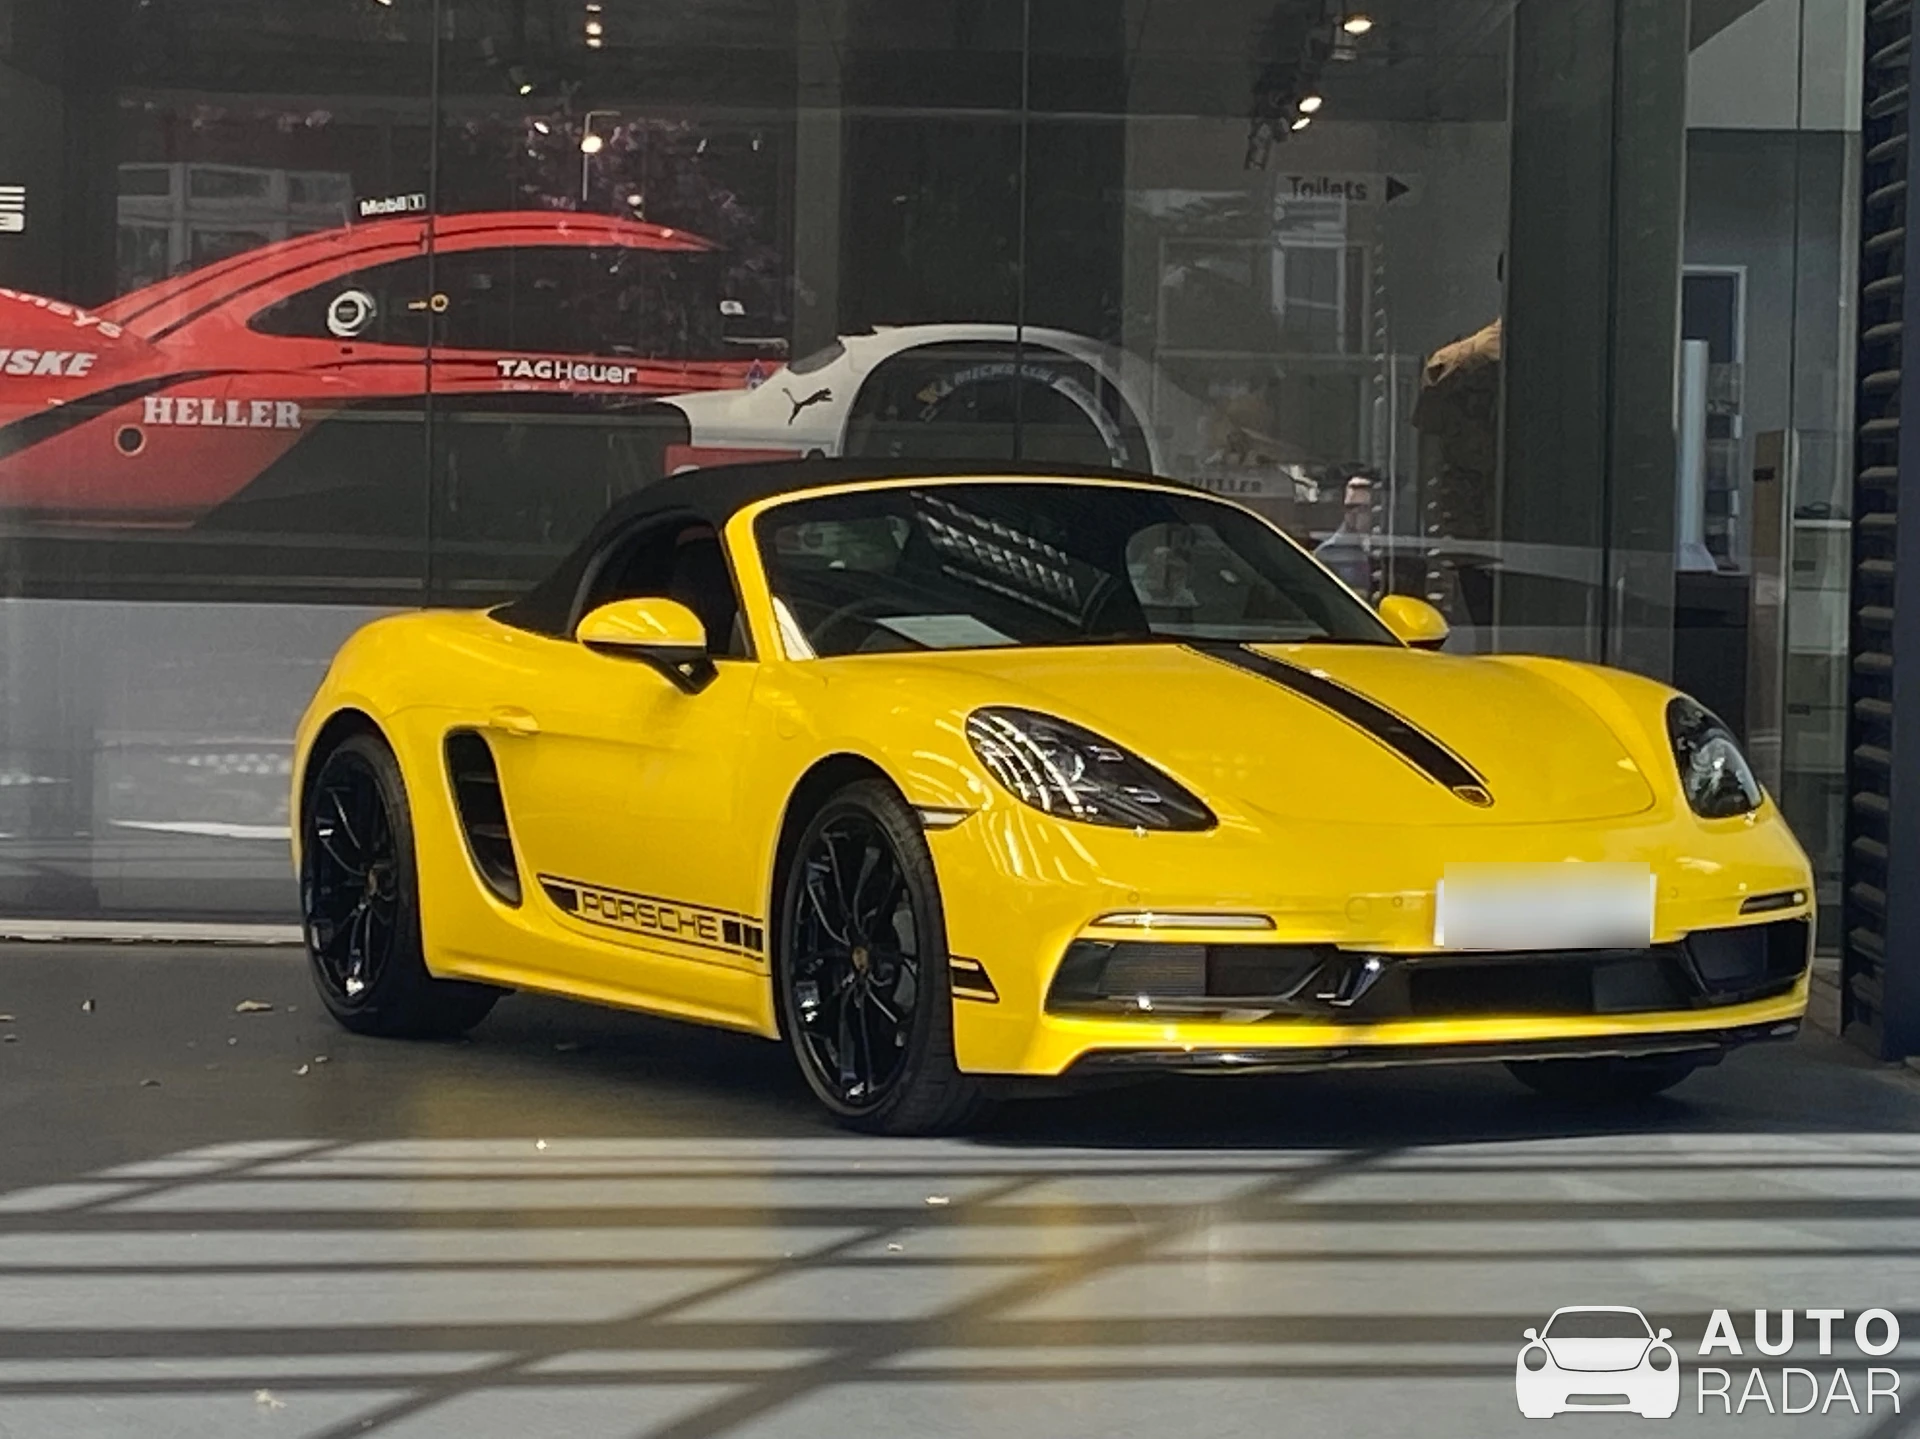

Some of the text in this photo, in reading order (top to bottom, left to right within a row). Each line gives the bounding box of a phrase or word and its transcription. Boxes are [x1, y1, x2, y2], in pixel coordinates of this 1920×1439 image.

[1285, 175, 1369, 200] Toilets
[143, 396, 301, 429] HELLER
[581, 890, 719, 942] PORSCHE
